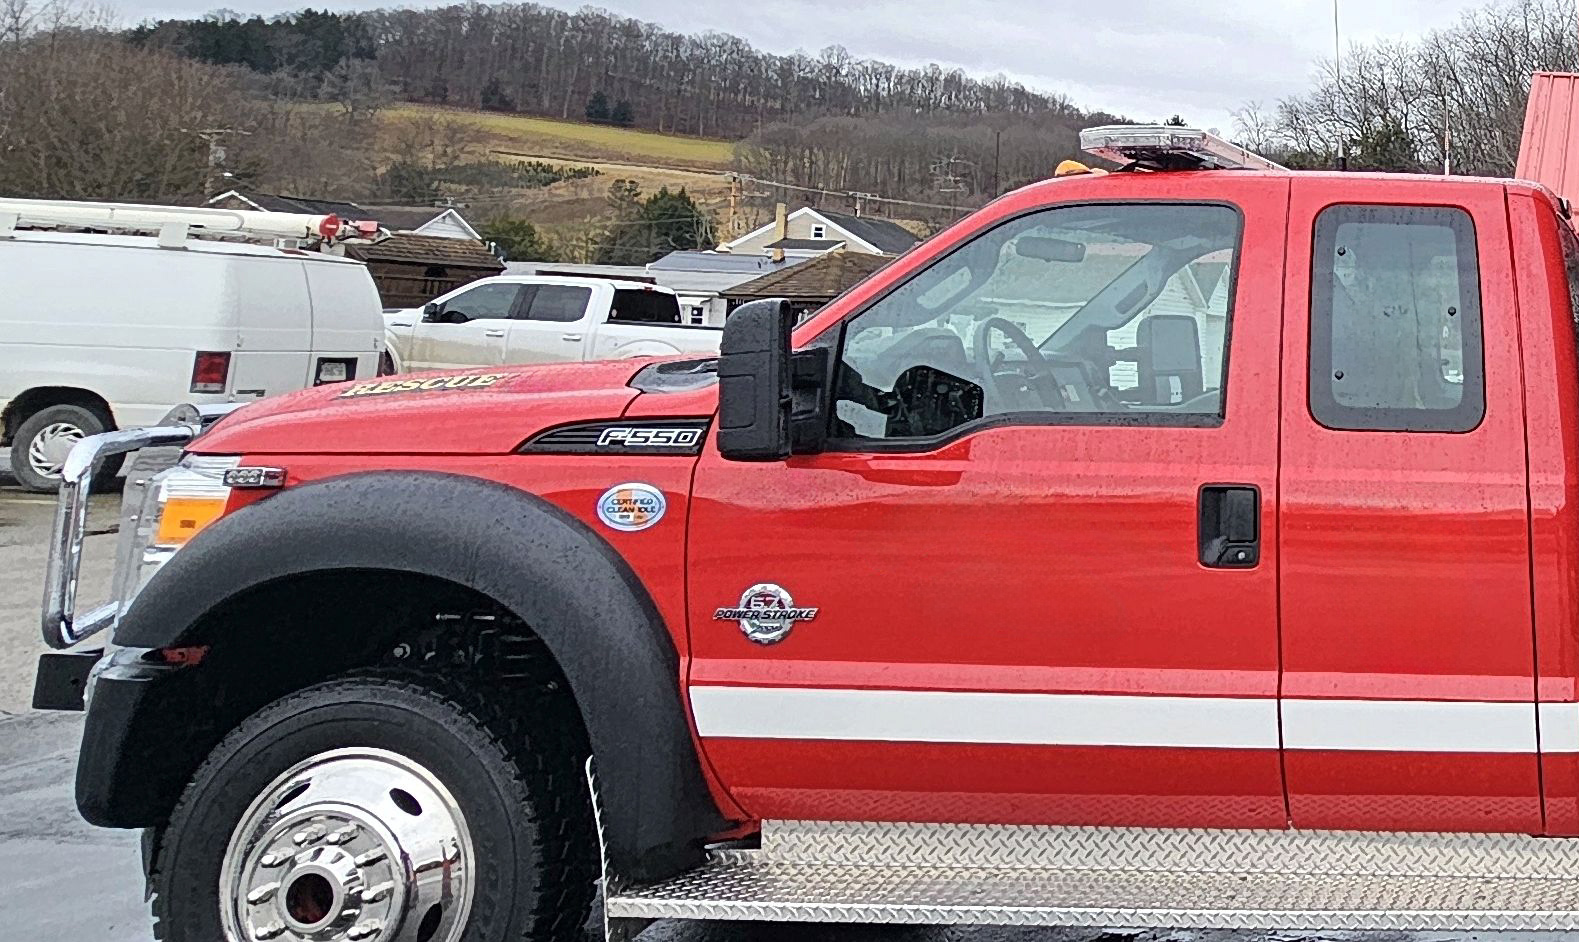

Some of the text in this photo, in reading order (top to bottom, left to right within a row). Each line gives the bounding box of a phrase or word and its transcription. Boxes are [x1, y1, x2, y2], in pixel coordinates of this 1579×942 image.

[336, 372, 508, 398] RESCUE
[611, 498, 654, 506] CERTIFIED
[606, 506, 656, 514] CLEAN IDLE
[714, 609, 817, 620] POWER STROKE
